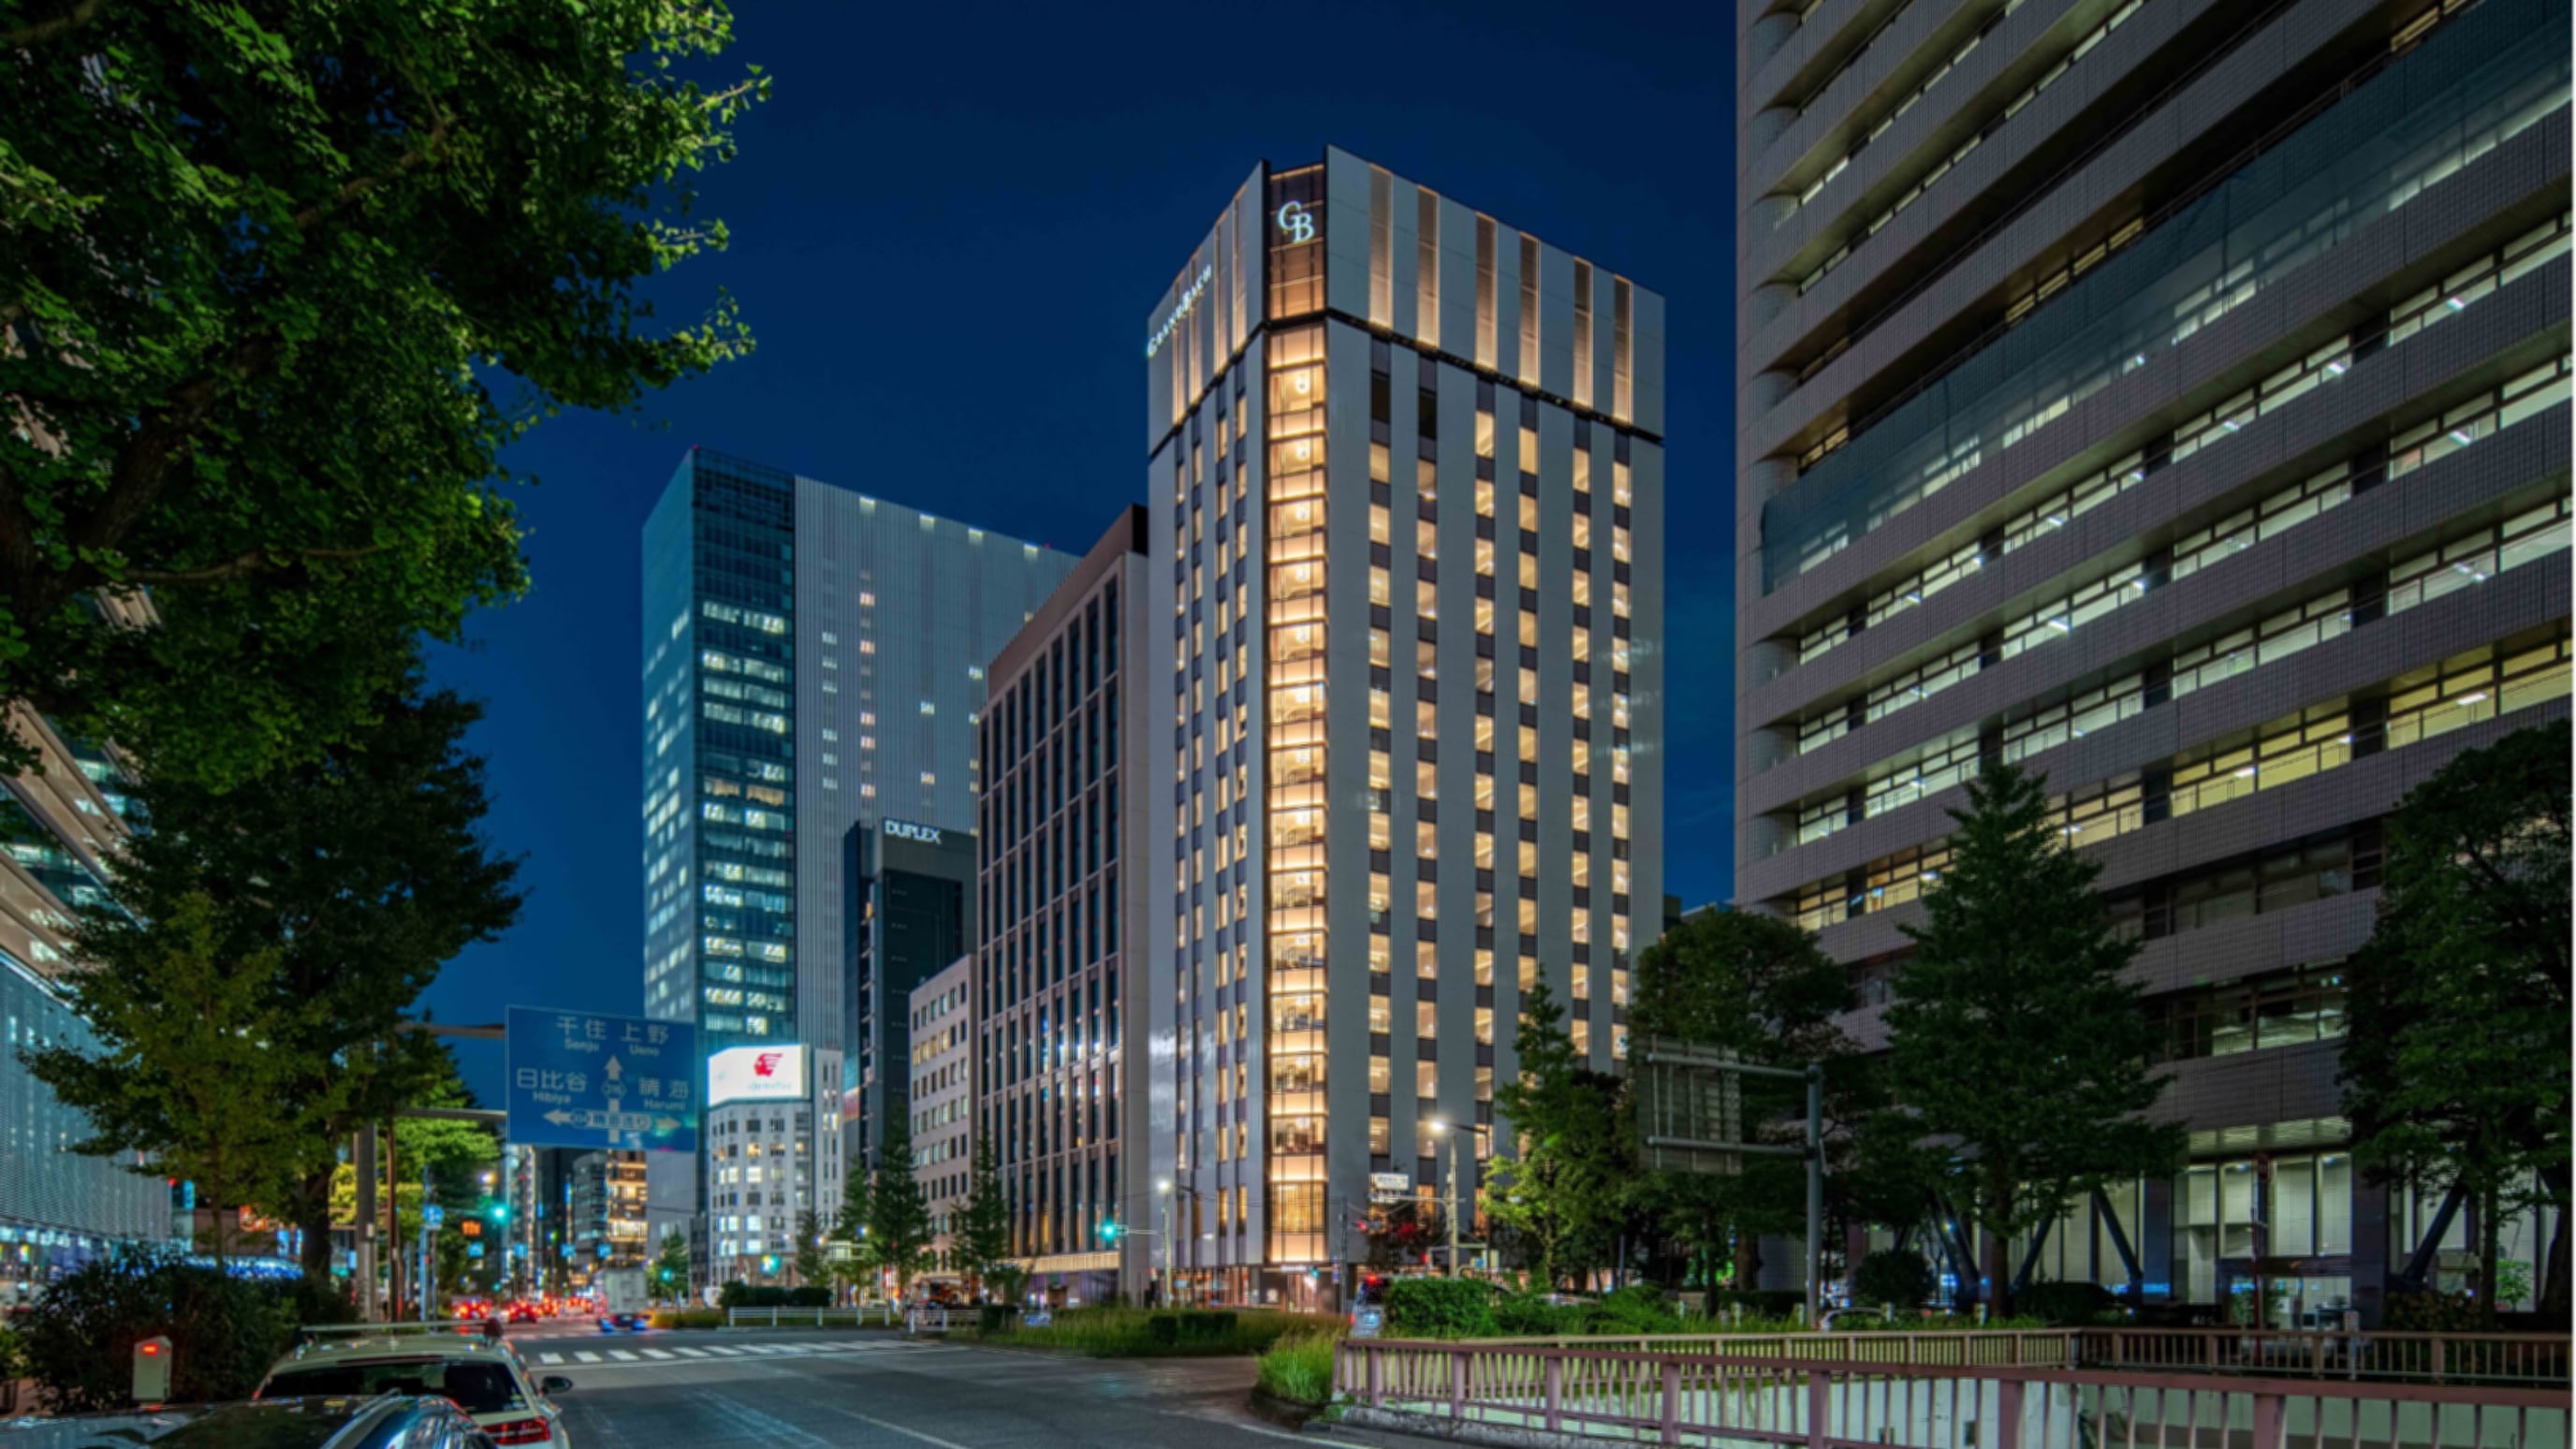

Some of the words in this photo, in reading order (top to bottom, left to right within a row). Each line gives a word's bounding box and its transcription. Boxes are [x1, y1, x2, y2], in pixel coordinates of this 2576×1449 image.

[885, 819, 942, 844] DUPLEX
[556, 1016, 607, 1040] 千住
[621, 1023, 668, 1045] 上野
[564, 1038, 599, 1052] Senju
[629, 1045, 660, 1057] Ueno
[517, 1067, 588, 1092] 日比谷
[638, 1076, 689, 1100] 晴海
[533, 1090, 571, 1105] Hibiya
[644, 1098, 685, 1111] Harumi
